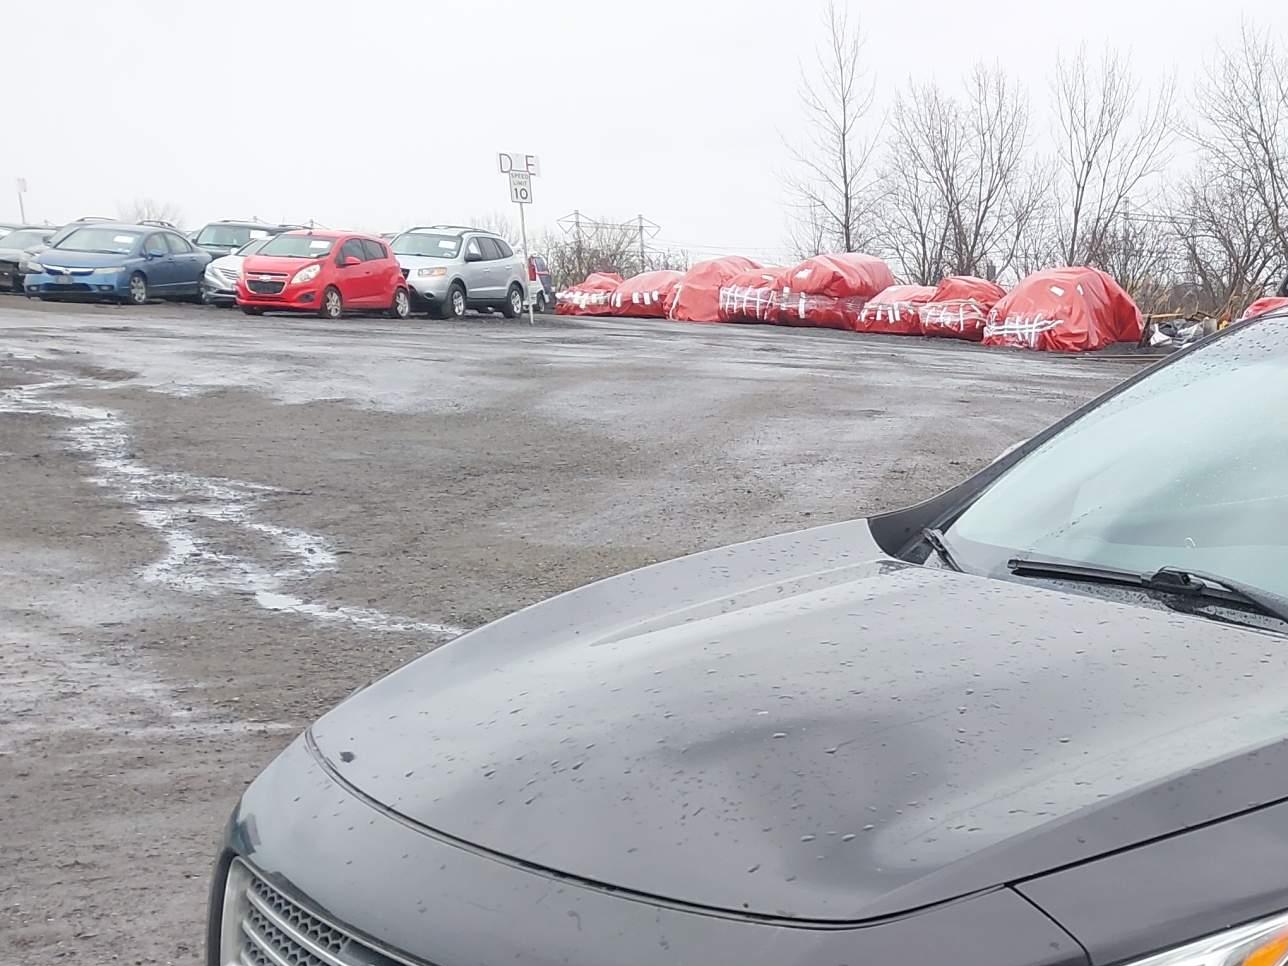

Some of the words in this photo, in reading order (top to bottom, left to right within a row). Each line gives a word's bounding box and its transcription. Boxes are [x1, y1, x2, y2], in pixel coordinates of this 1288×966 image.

[499, 153, 513, 174] D
[525, 154, 537, 176] E
[514, 187, 529, 200] 10
